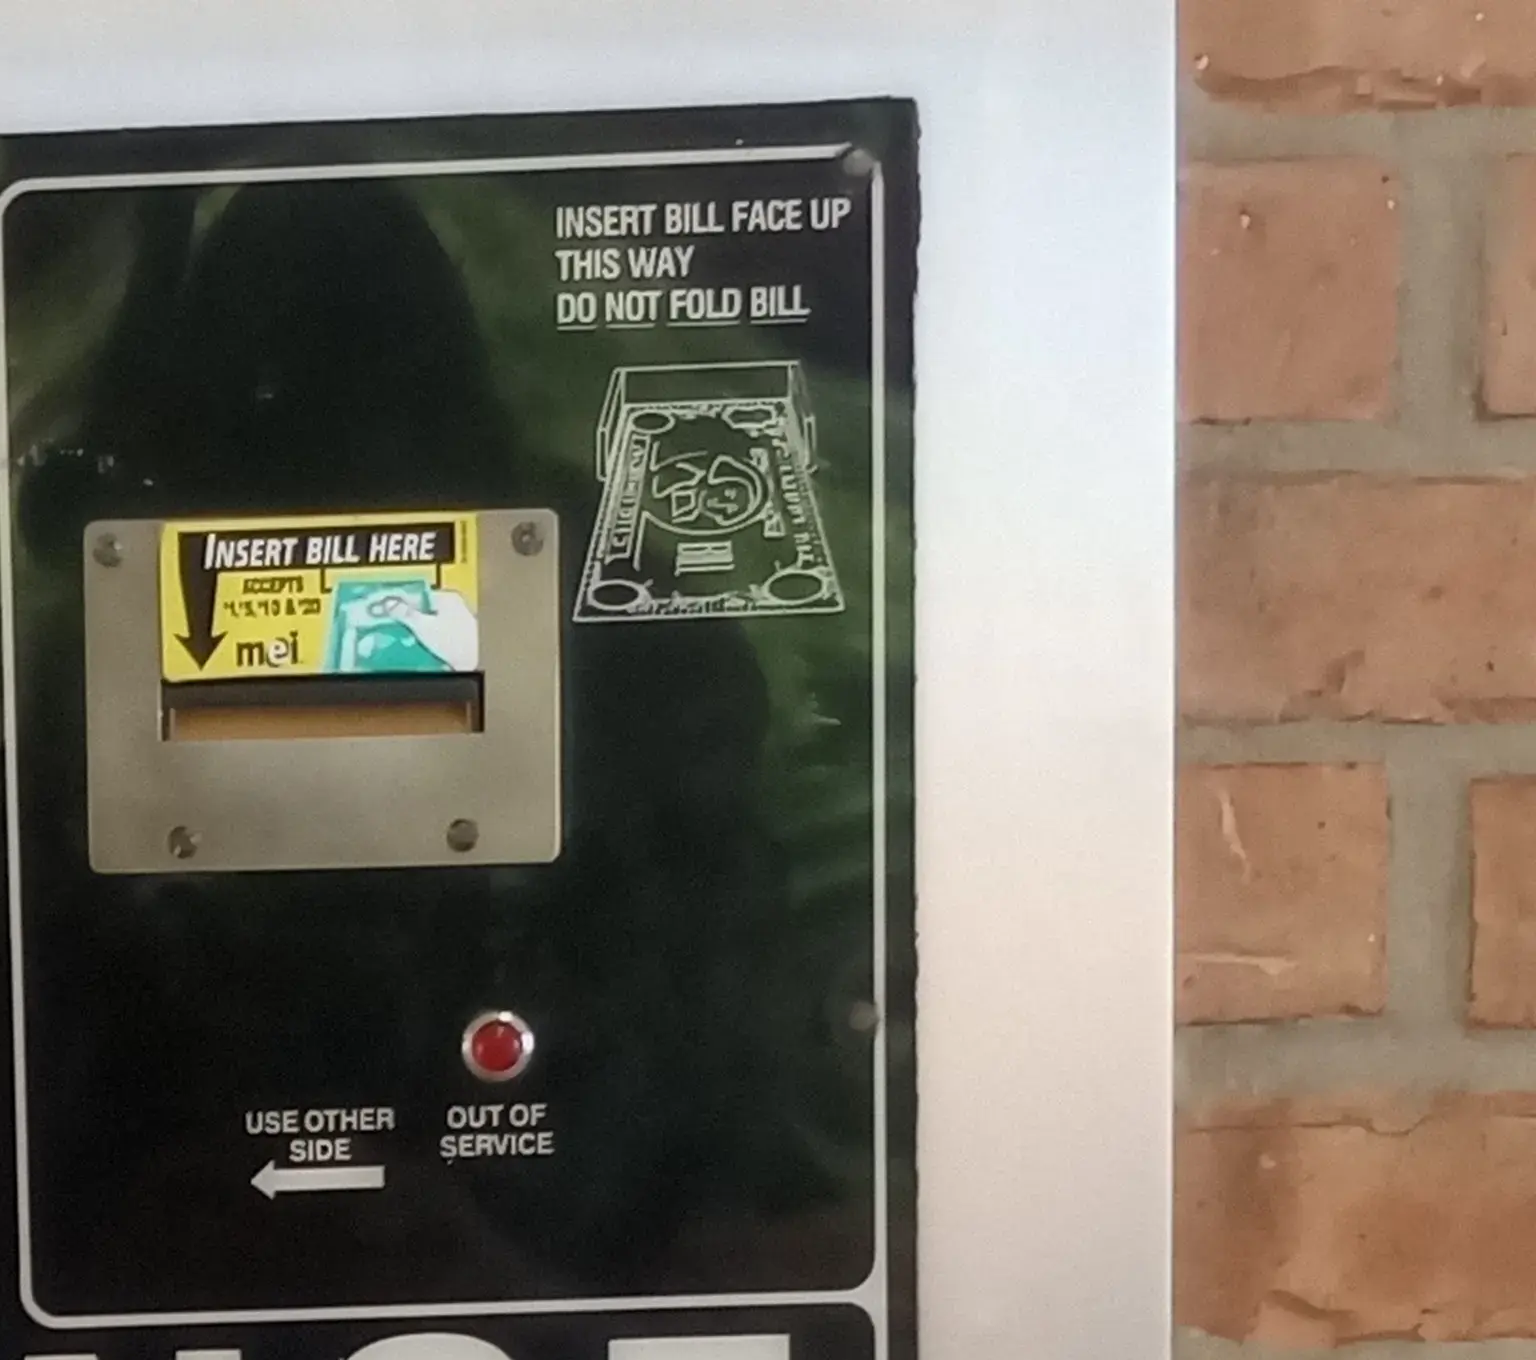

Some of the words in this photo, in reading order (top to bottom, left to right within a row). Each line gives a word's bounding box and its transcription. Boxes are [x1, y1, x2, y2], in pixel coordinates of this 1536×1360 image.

[556, 203, 657, 238] INSERT
[665, 201, 724, 234] BILL
[732, 199, 803, 232] FACE
[810, 198, 851, 230] UP
[555, 249, 621, 281] THIS
[627, 245, 695, 278] WAY
[557, 292, 597, 324] DO
[605, 290, 662, 322] NOT
[670, 288, 742, 320] FOLD
[750, 285, 811, 317] BILL
[204, 533, 298, 569] INSERT
[305, 534, 360, 566] BILL
[369, 531, 436, 562] HERE
[236, 629, 298, 668] mei
[245, 1109, 301, 1135] USE
[303, 1107, 395, 1133] OTHER
[447, 1103, 505, 1129] OUT
[509, 1103, 547, 1127] OF
[289, 1137, 352, 1162] SIDE
[440, 1131, 555, 1158] SERVICE
